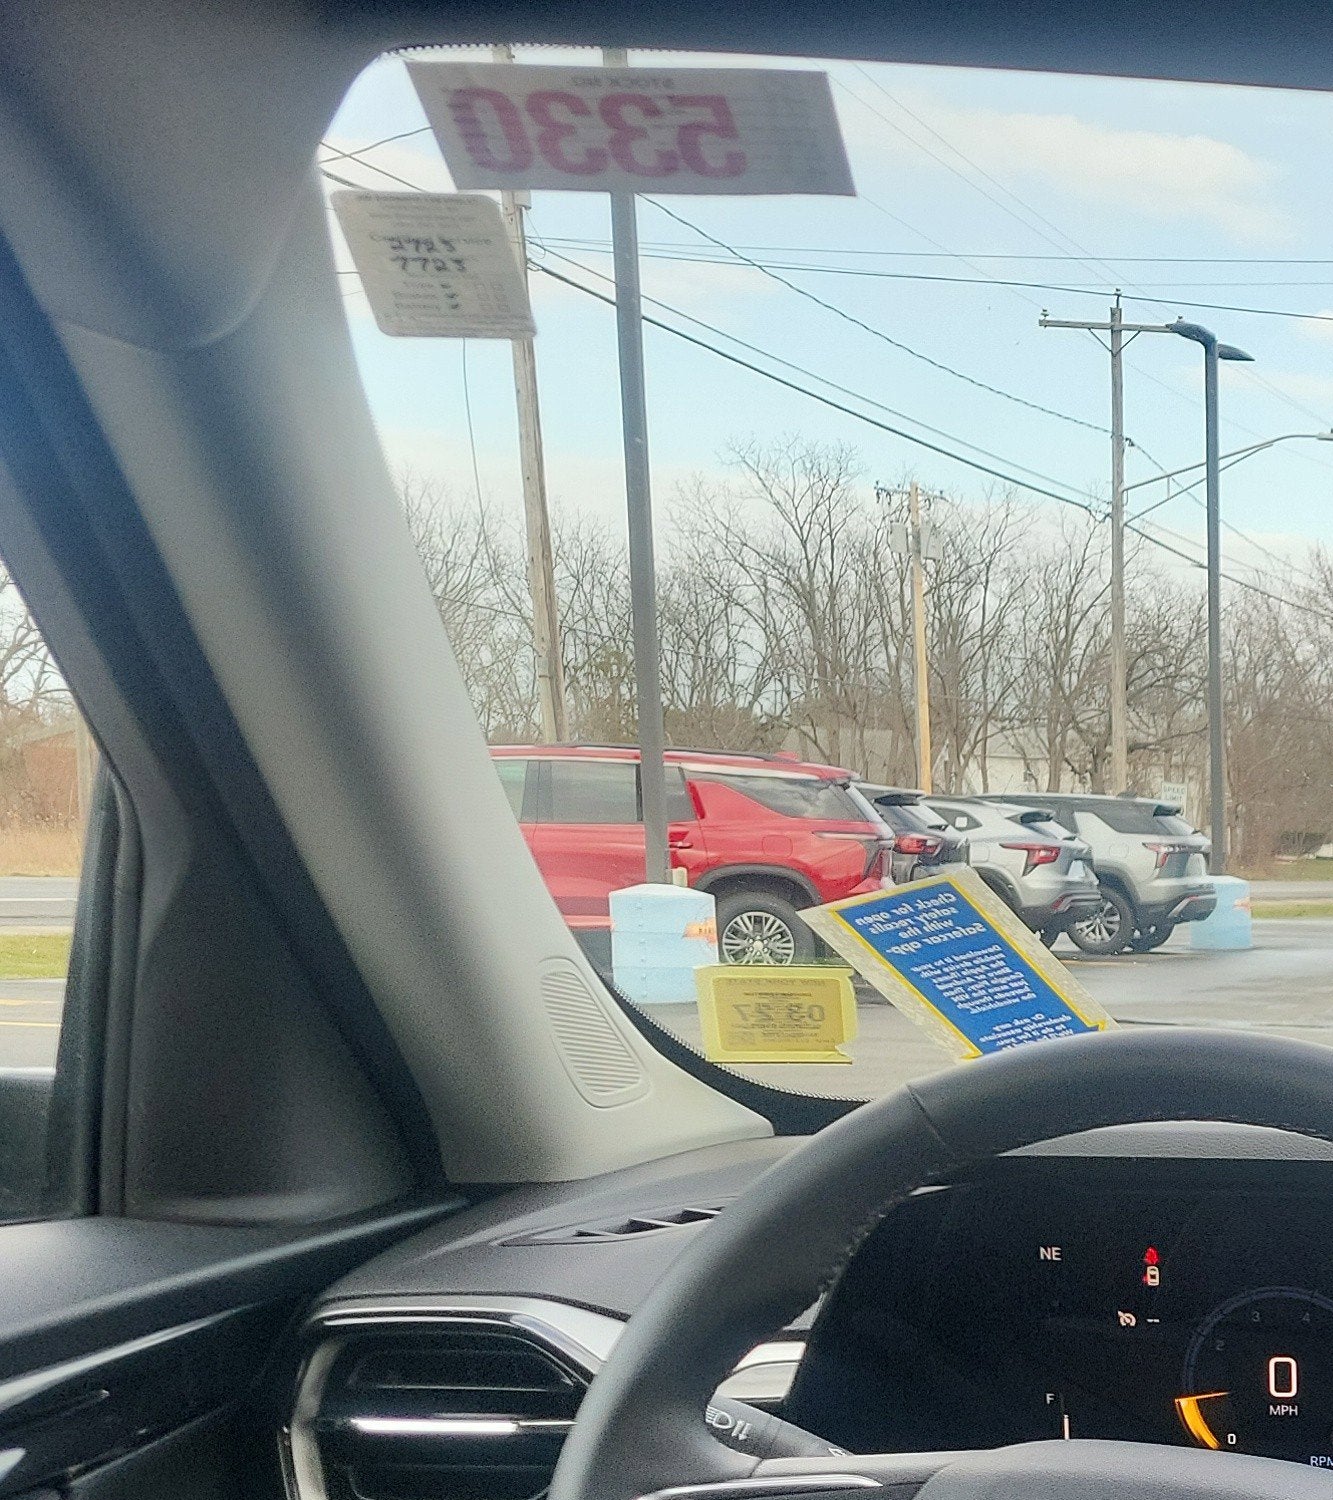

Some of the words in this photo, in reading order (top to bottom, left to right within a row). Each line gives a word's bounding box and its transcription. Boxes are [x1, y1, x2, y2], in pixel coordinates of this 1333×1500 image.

[1040, 1247, 1062, 1261] NE
[1252, 1311, 1261, 1322] 3
[1302, 1312, 1311, 1323] 4
[1215, 1340, 1225, 1351] 2
[1269, 1356, 1298, 1398] 0
[1046, 1393, 1055, 1405] F
[1269, 1405, 1298, 1416] MPH
[1227, 1433, 1236, 1445] 0
